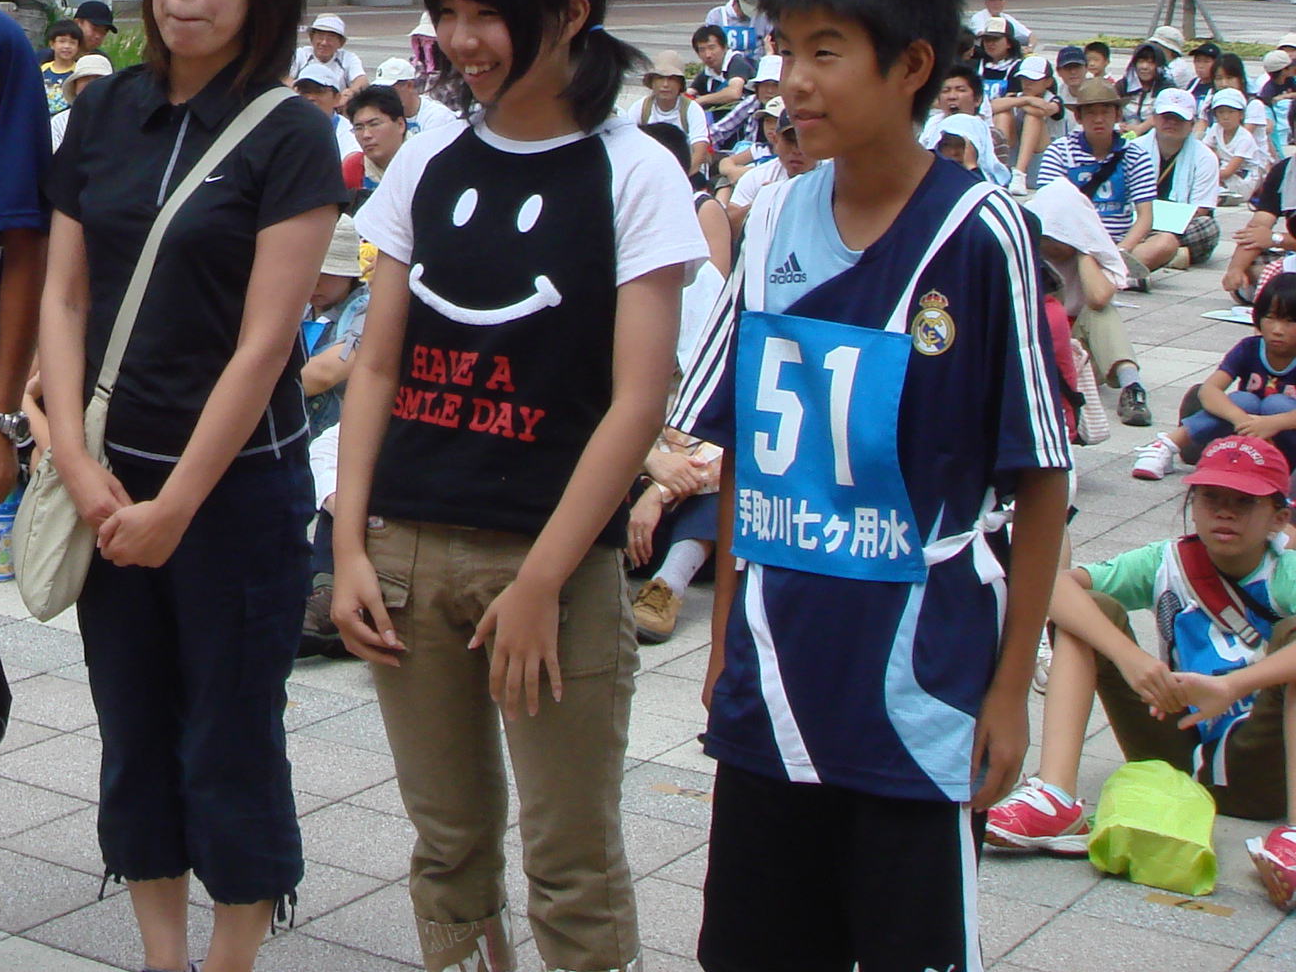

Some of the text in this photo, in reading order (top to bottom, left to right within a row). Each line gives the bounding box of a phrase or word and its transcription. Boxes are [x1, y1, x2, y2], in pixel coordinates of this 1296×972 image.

[727, 29, 749, 49] 61
[769, 271, 807, 284] adidas
[410, 344, 516, 392] HAVE A
[469, 398, 545, 442] DAY
[754, 337, 861, 487] 51
